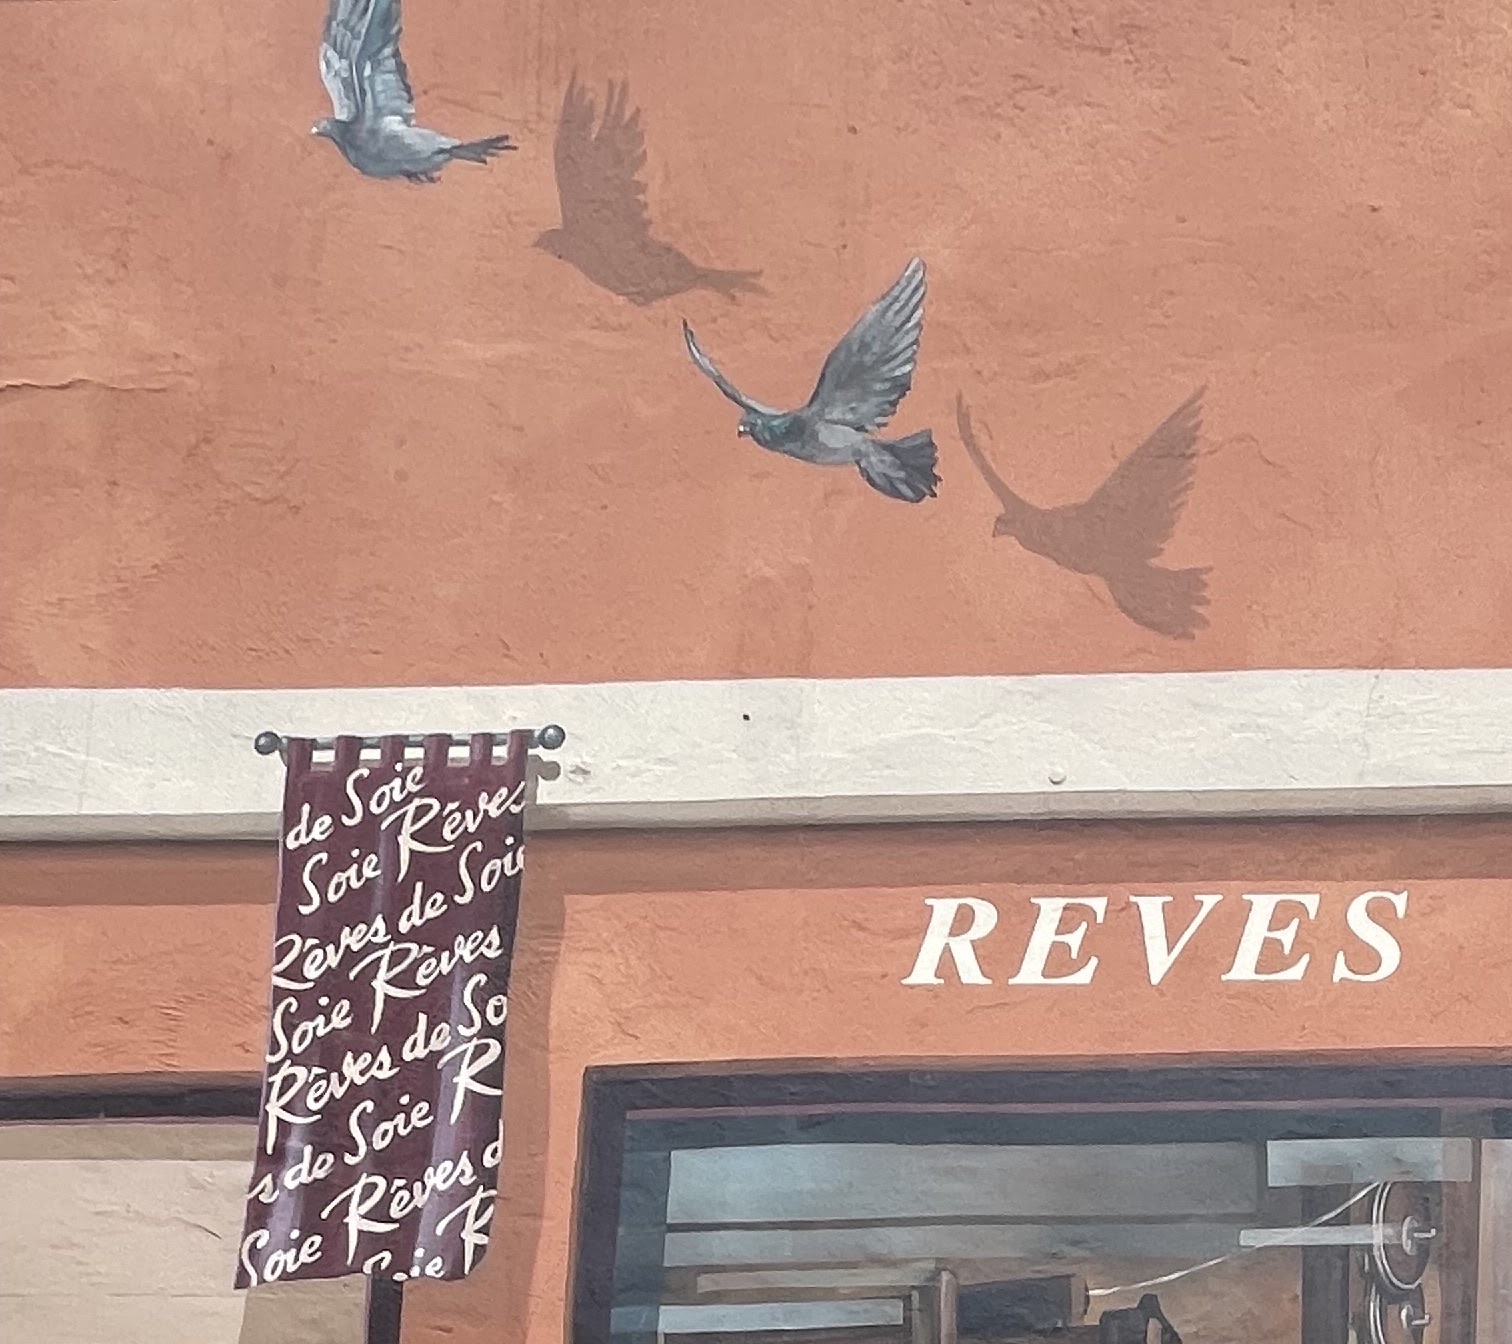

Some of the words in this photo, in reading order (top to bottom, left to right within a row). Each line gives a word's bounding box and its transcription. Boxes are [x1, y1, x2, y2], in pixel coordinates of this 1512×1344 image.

[285, 803, 334, 850] de
[341, 762, 426, 826] Soie
[298, 848, 382, 915] Soie
[399, 881, 448, 934] de
[901, 890, 1408, 986] REVES
[265, 996, 352, 1063] Soie
[401, 1012, 451, 1062] de
[284, 1144, 335, 1191] de
[344, 1094, 434, 1165] Soie
[437, 1037, 503, 1125] R
[241, 1229, 323, 1285] Soie
